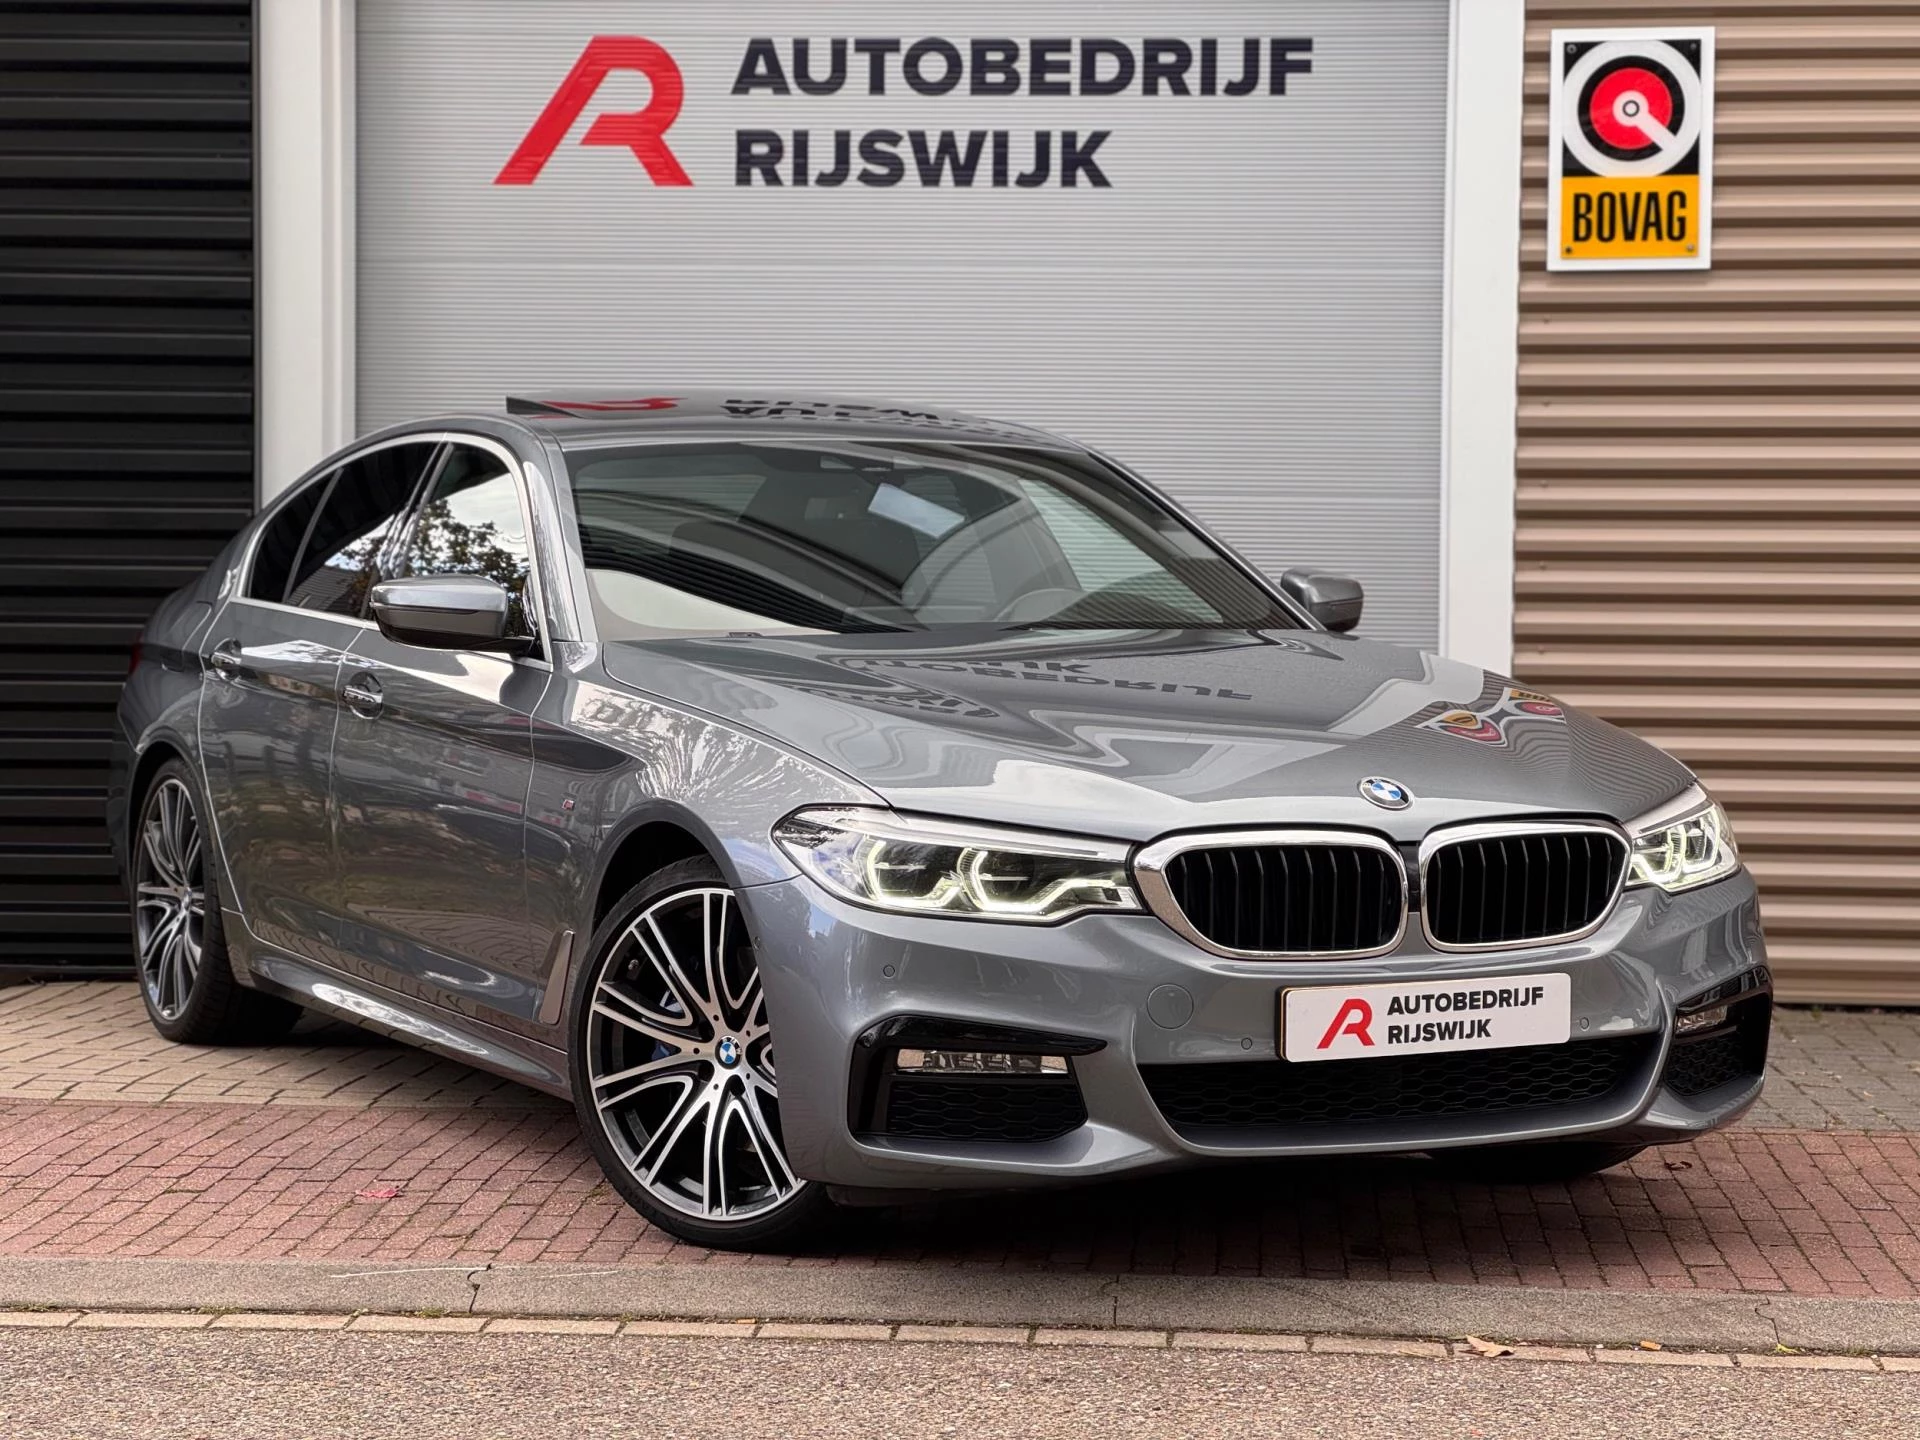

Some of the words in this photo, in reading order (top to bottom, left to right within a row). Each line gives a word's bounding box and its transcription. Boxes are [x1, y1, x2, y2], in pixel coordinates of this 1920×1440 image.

[732, 37, 1314, 97] AUTOBEDRIJF
[736, 129, 1112, 188] RIJSWIJK
[1573, 190, 1687, 243] BOVAG
[1387, 986, 1544, 1016] AUTOBEDRIJF
[1387, 1018, 1492, 1045] RIJSWIJK
